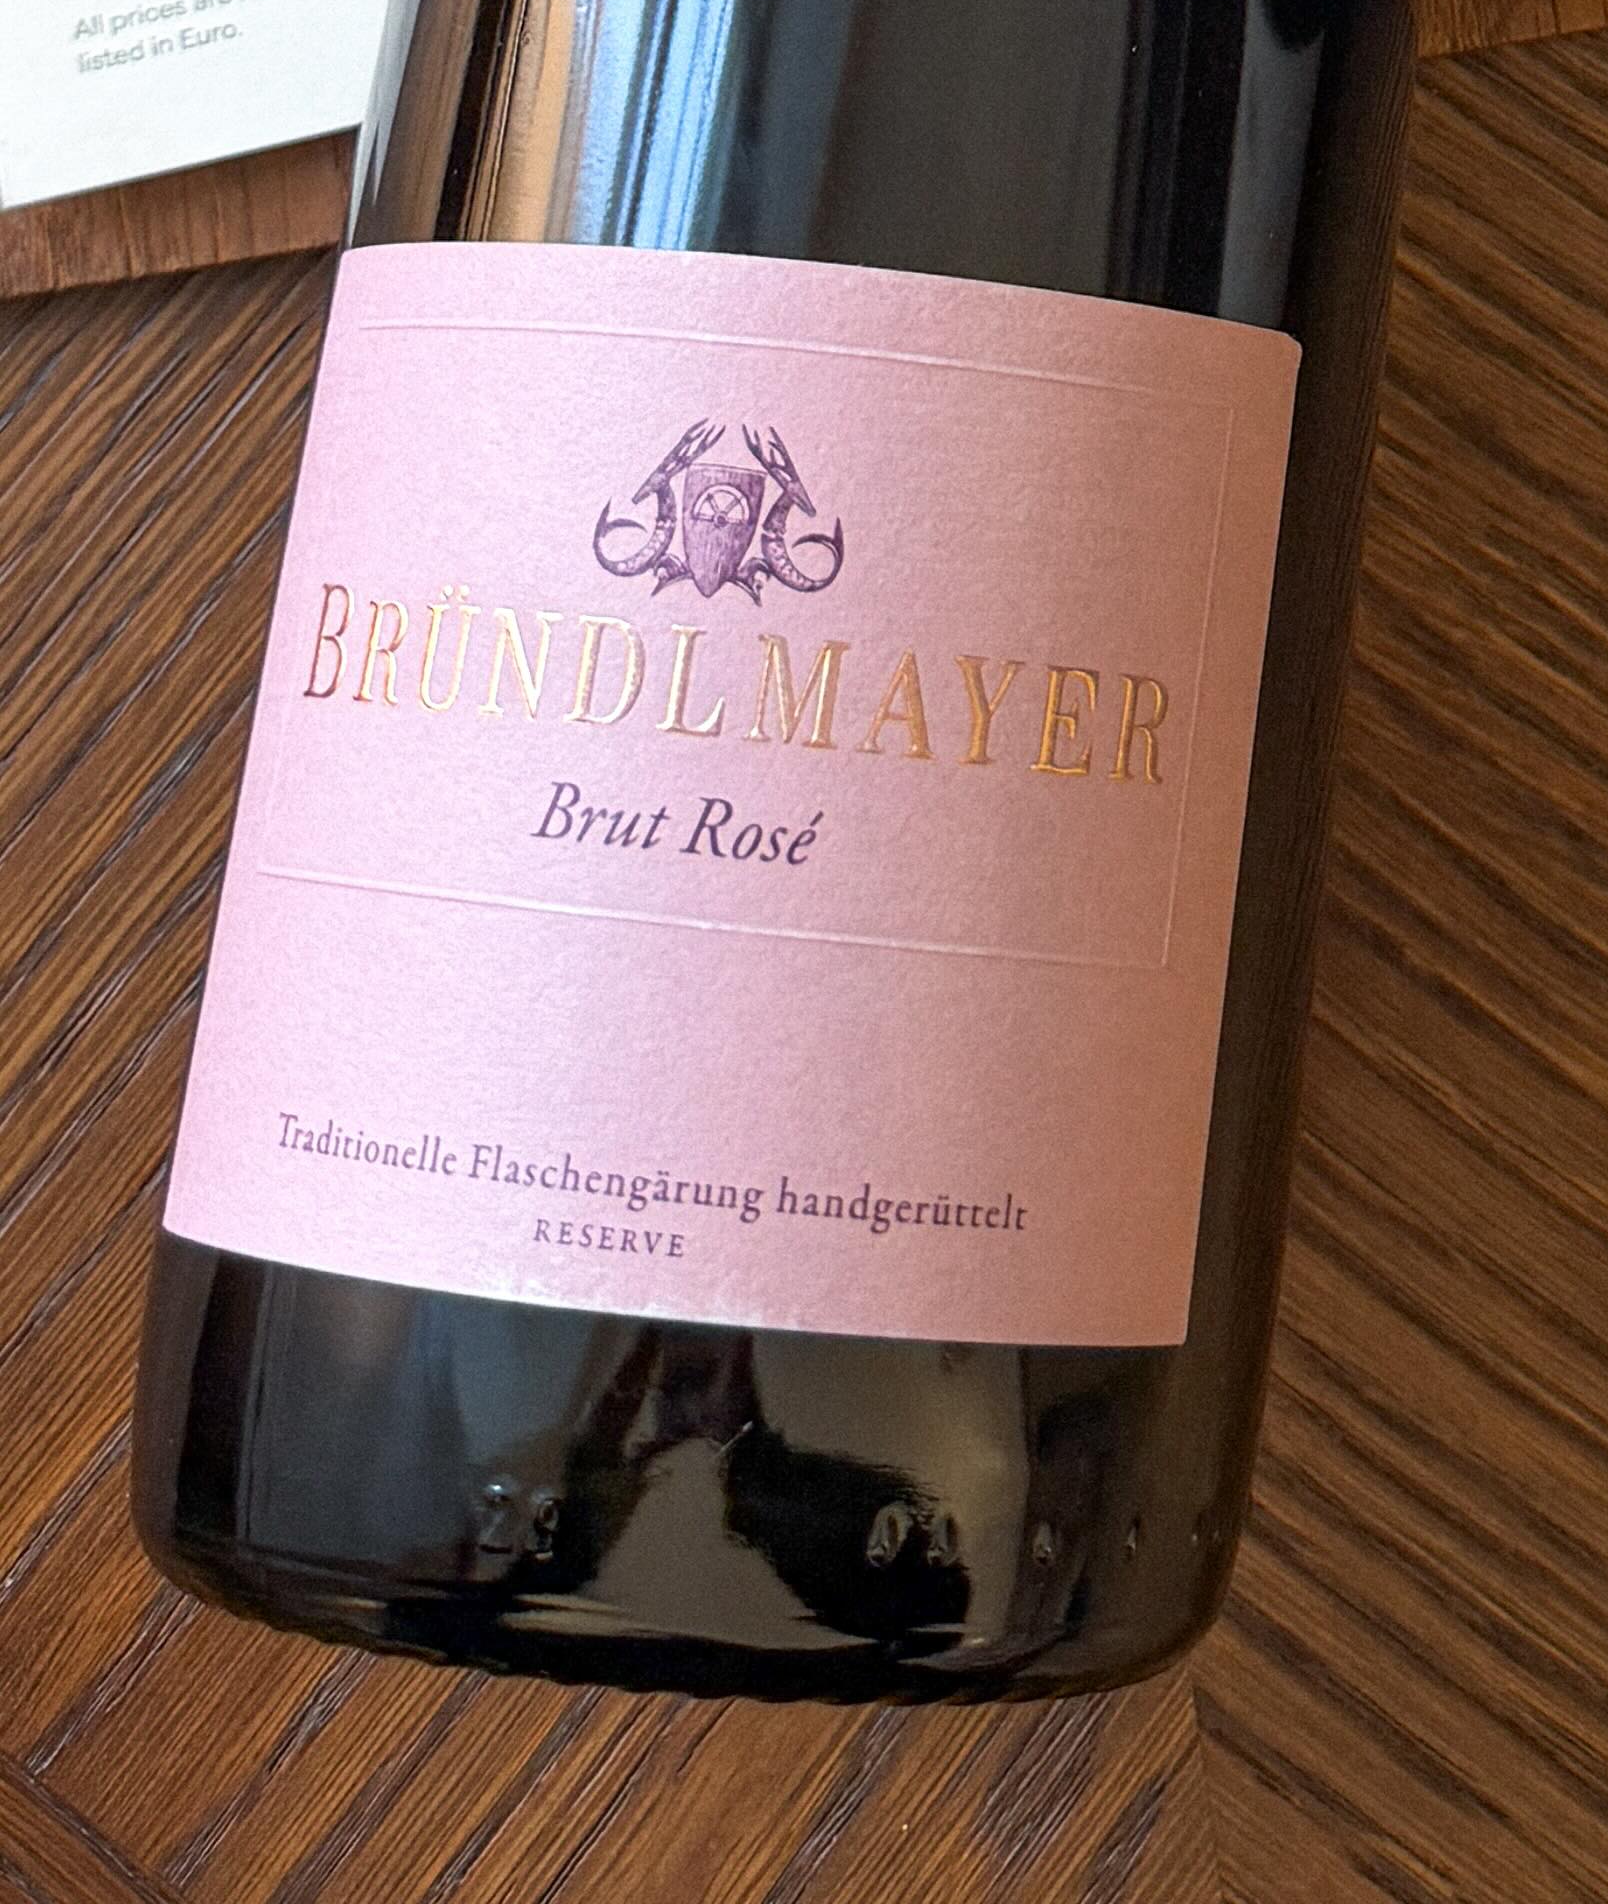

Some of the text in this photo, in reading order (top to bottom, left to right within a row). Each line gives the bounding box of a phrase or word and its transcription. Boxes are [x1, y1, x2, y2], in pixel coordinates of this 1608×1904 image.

[72, 14, 104, 40] All
[109, 0, 188, 37] prices
[75, 23, 243, 74] listed in Euro.
[303, 583, 1170, 786] BRÜNDLMAYER
[530, 780, 824, 866] Brut Rosé
[278, 1112, 1026, 1234] Traditionelle Flaschengärung handgerüttelt
[533, 1218, 684, 1259] RESERVE
